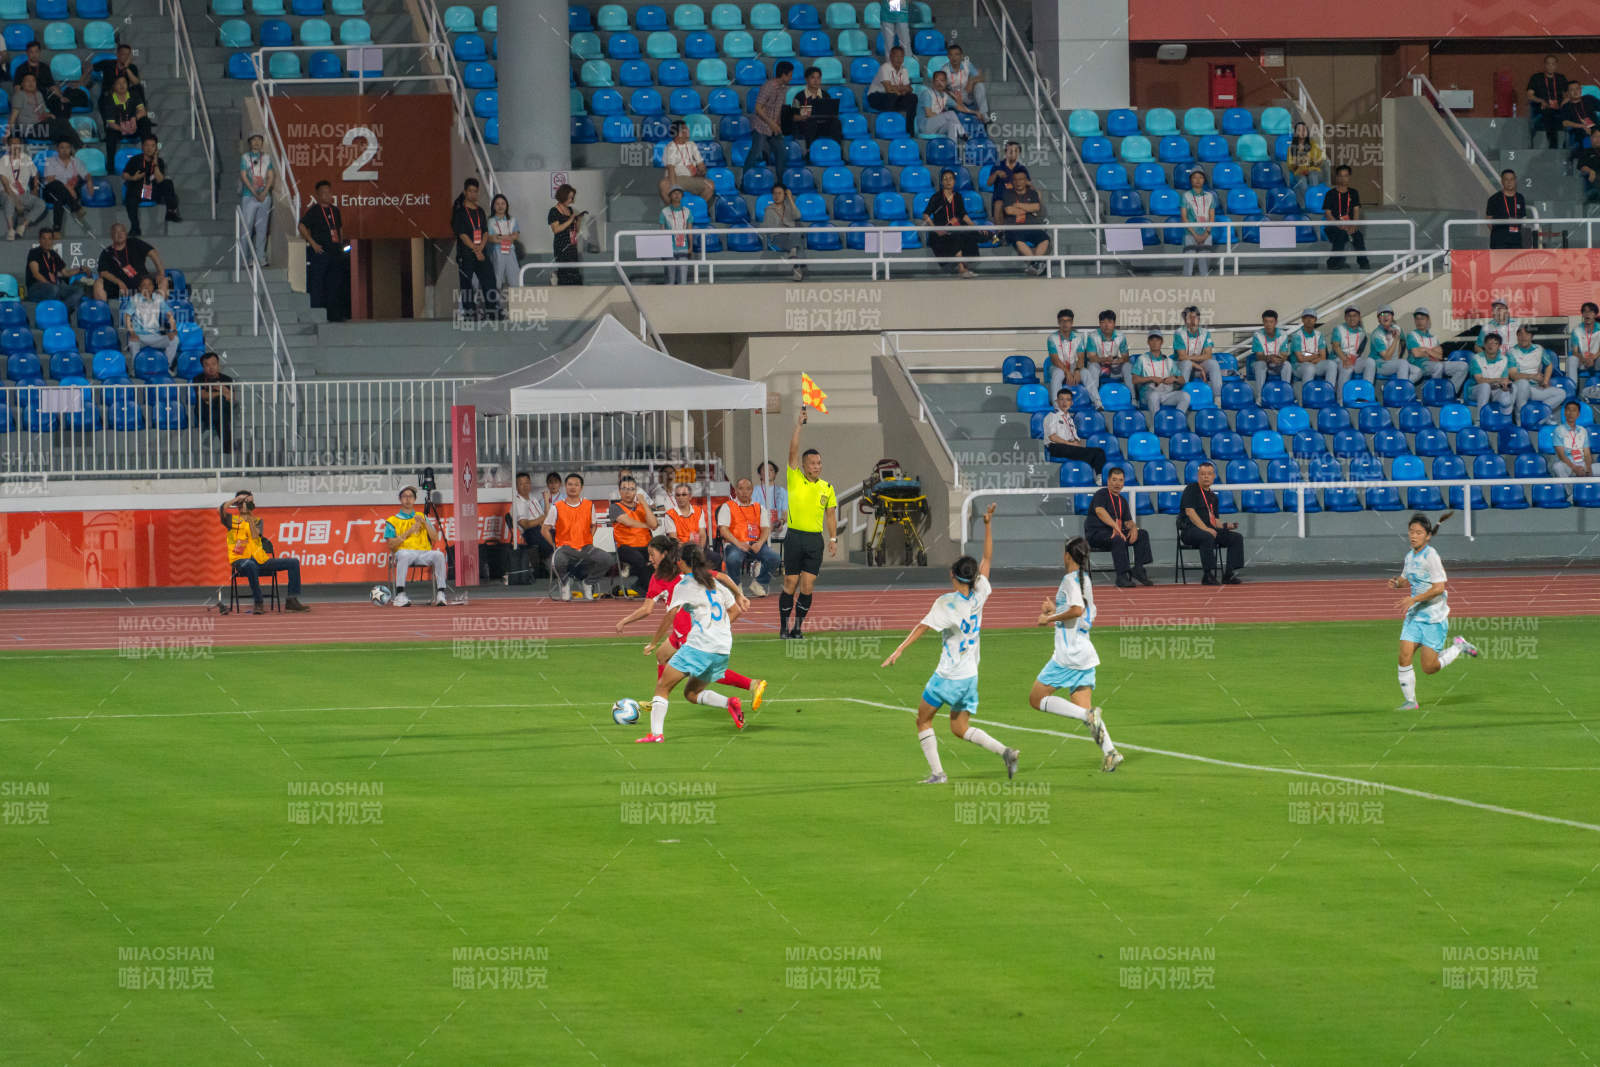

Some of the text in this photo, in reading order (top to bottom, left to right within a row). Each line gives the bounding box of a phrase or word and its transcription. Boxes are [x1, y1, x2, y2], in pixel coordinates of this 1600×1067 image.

[1490, 119, 1496, 128] 4
[341, 127, 379, 181] 2
[1508, 151, 1515, 160] 3
[1525, 178, 1532, 187] 2
[342, 193, 431, 207] Entrance/Exit
[1542, 203, 1547, 211] 1
[70, 242, 84, 256] 区
[70, 255, 98, 269] Are
[985, 385, 992, 396] 6
[1000, 414, 1006, 424] 5
[1013, 440, 1019, 451] 4
[1028, 463, 1034, 474] 3
[1059, 517, 1064, 527] 1
[705, 588, 723, 622] 5
